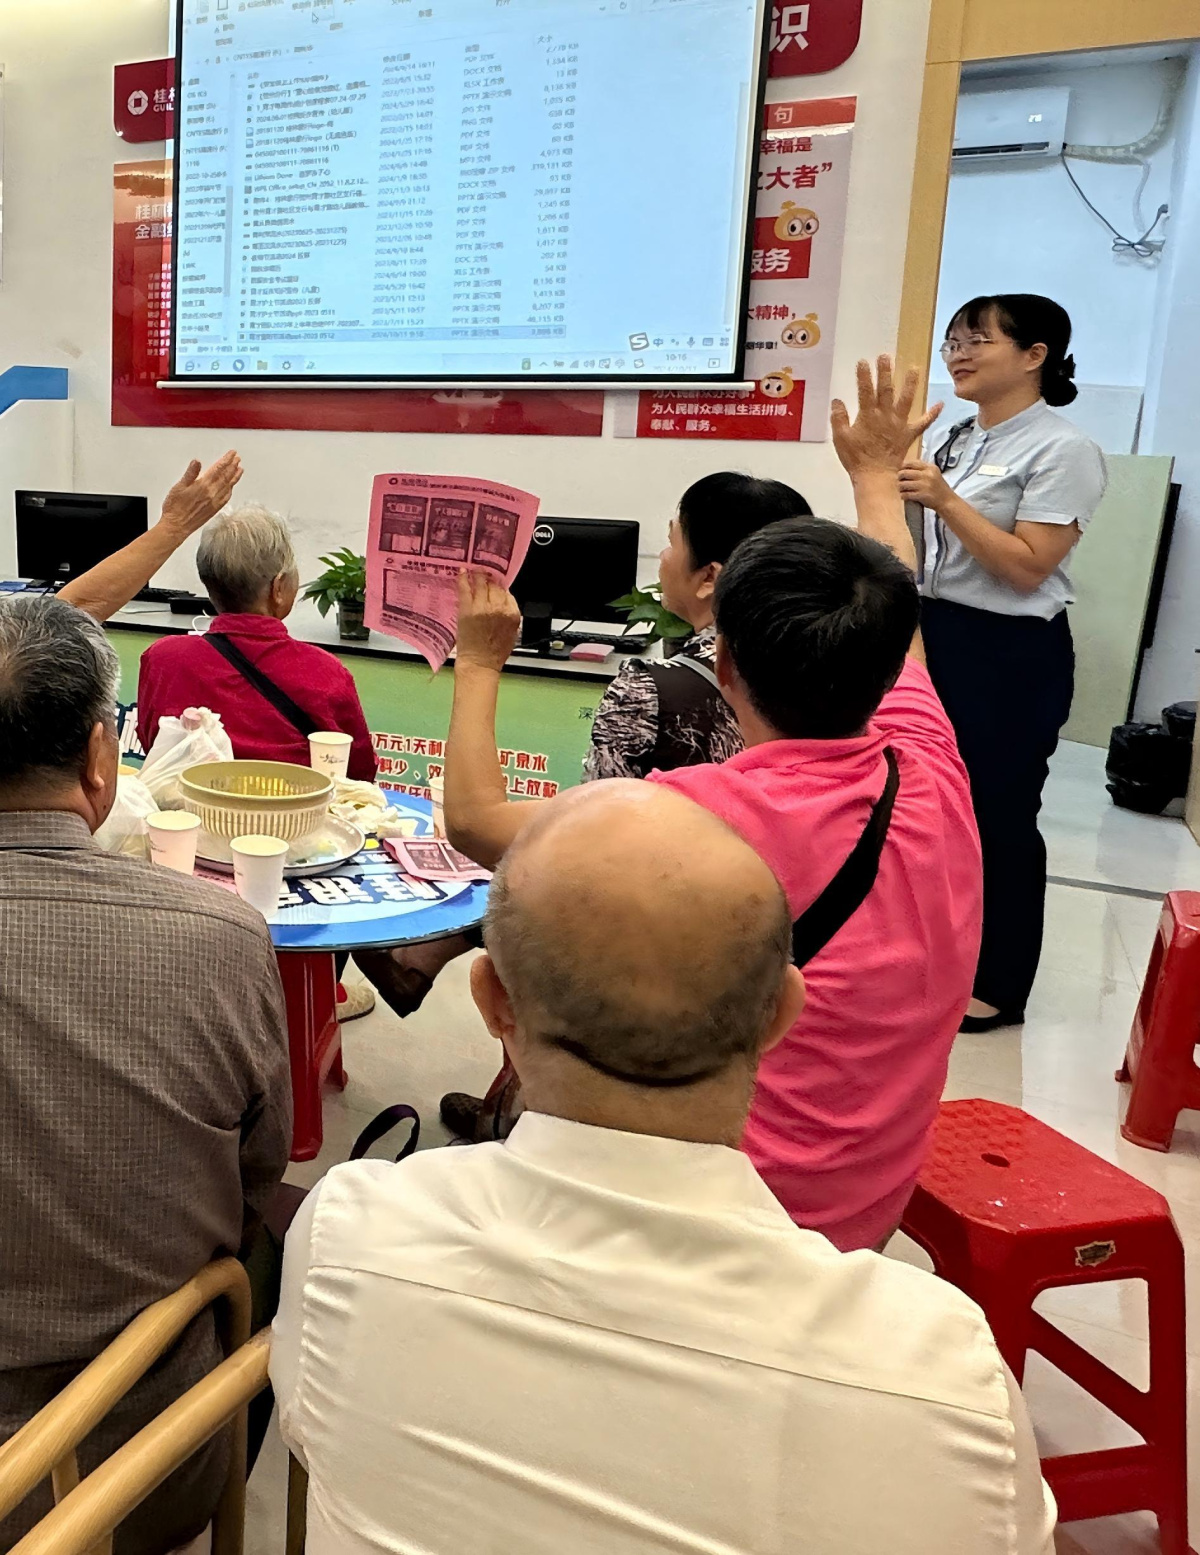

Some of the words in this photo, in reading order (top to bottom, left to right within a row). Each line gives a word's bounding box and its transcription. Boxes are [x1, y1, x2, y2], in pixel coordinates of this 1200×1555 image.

[770, 4, 810, 52] 识
[464, 66, 485, 76] DOCX
[774, 106, 794, 125] 句
[760, 136, 813, 155] 幸福是
[458, 182, 479, 190] DOCX
[666, 353, 688, 361] 10:16
[535, 531, 551, 539] DELL
[578, 706, 593, 720] 深
[369, 733, 446, 758] 万元1天利
[499, 750, 547, 772] 矿泉水
